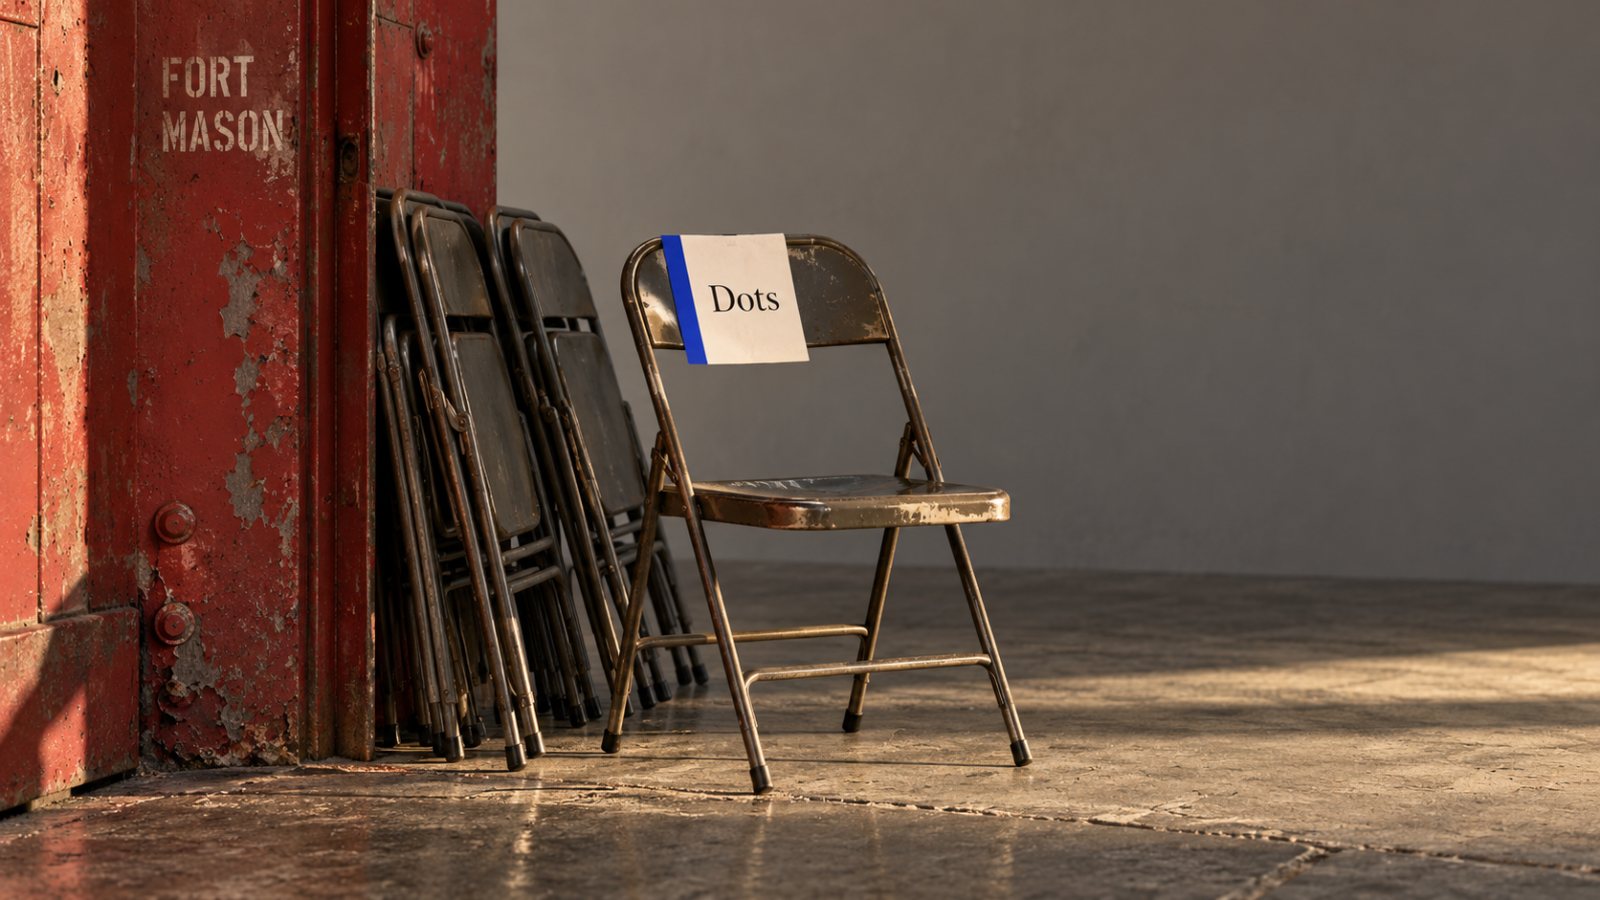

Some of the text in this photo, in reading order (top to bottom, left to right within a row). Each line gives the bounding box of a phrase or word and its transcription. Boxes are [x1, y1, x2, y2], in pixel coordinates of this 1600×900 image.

[162, 56, 254, 98] FORT
[162, 110, 283, 152] MASON
[708, 284, 780, 312] Dots
